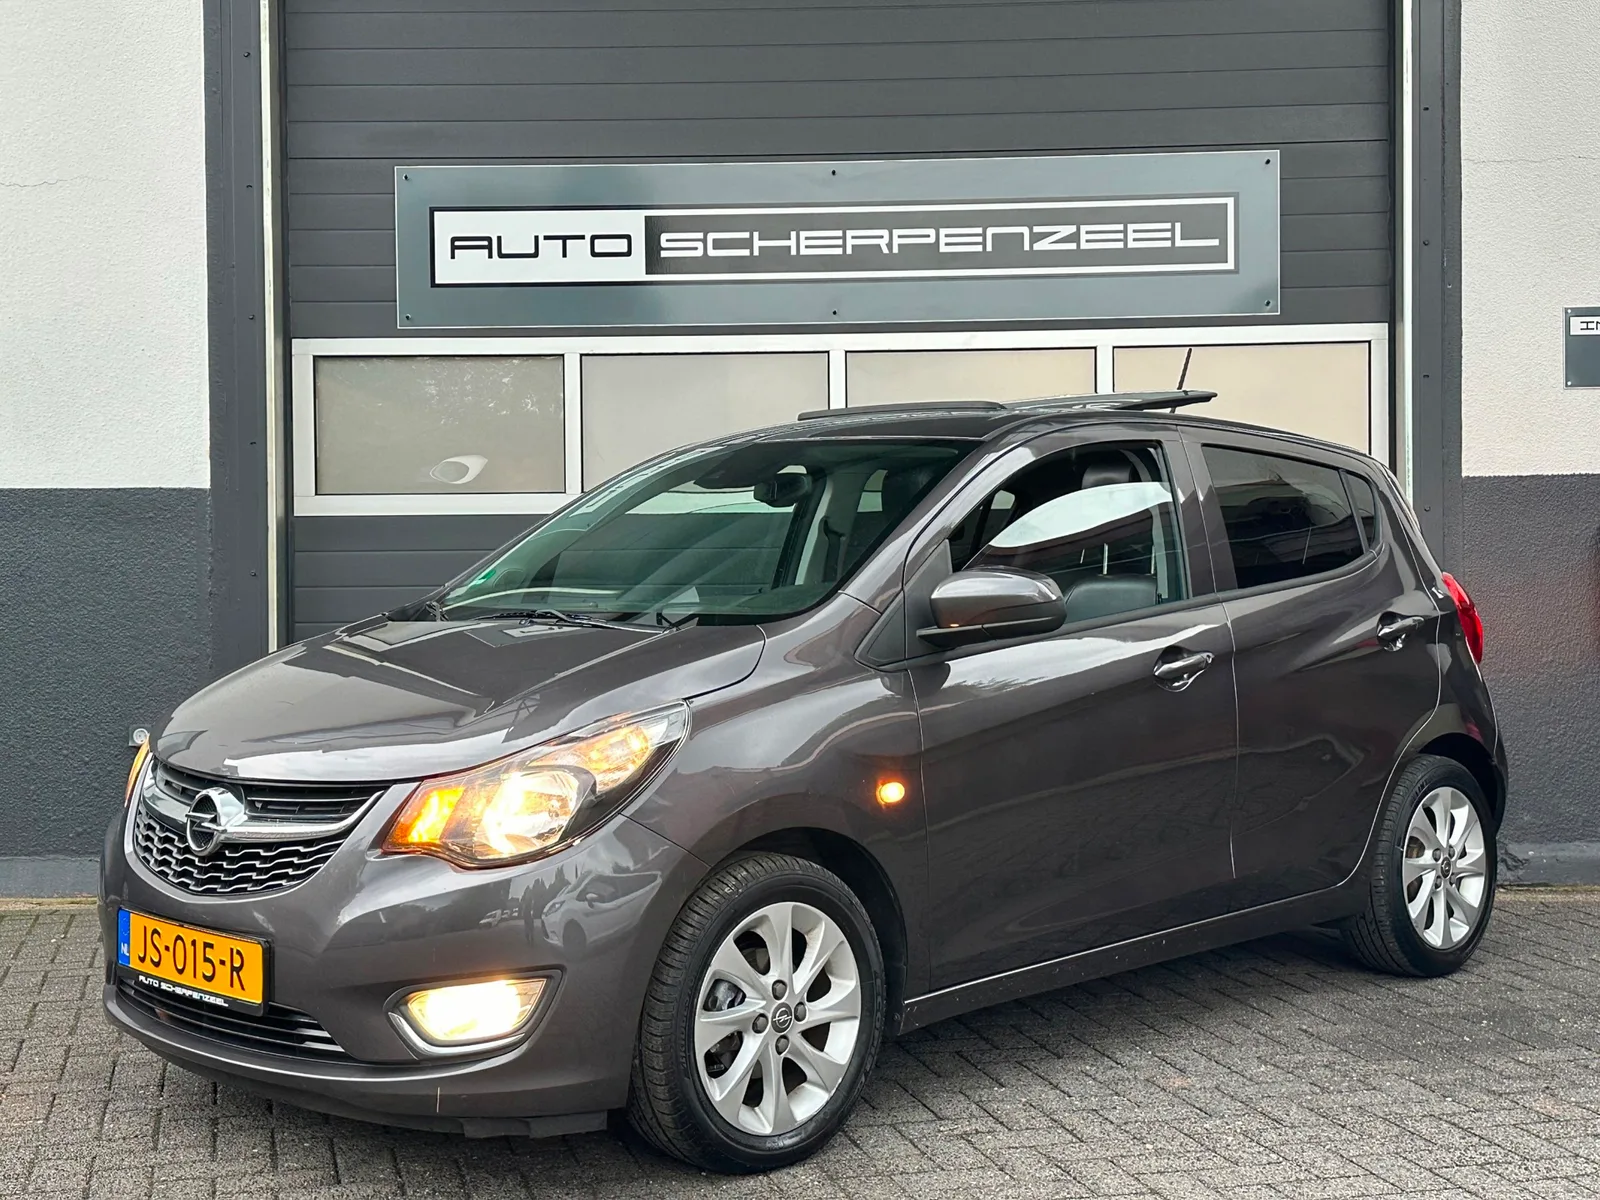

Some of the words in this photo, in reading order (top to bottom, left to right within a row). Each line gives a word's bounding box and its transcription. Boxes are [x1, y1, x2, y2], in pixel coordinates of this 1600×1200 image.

[450, 234, 632, 260] AUTO
[659, 221, 1220, 259] SCHERPENZEEL
[121, 942, 130, 956] NL
[138, 925, 245, 991] JS-015-R
[138, 975, 159, 987] AUTO
